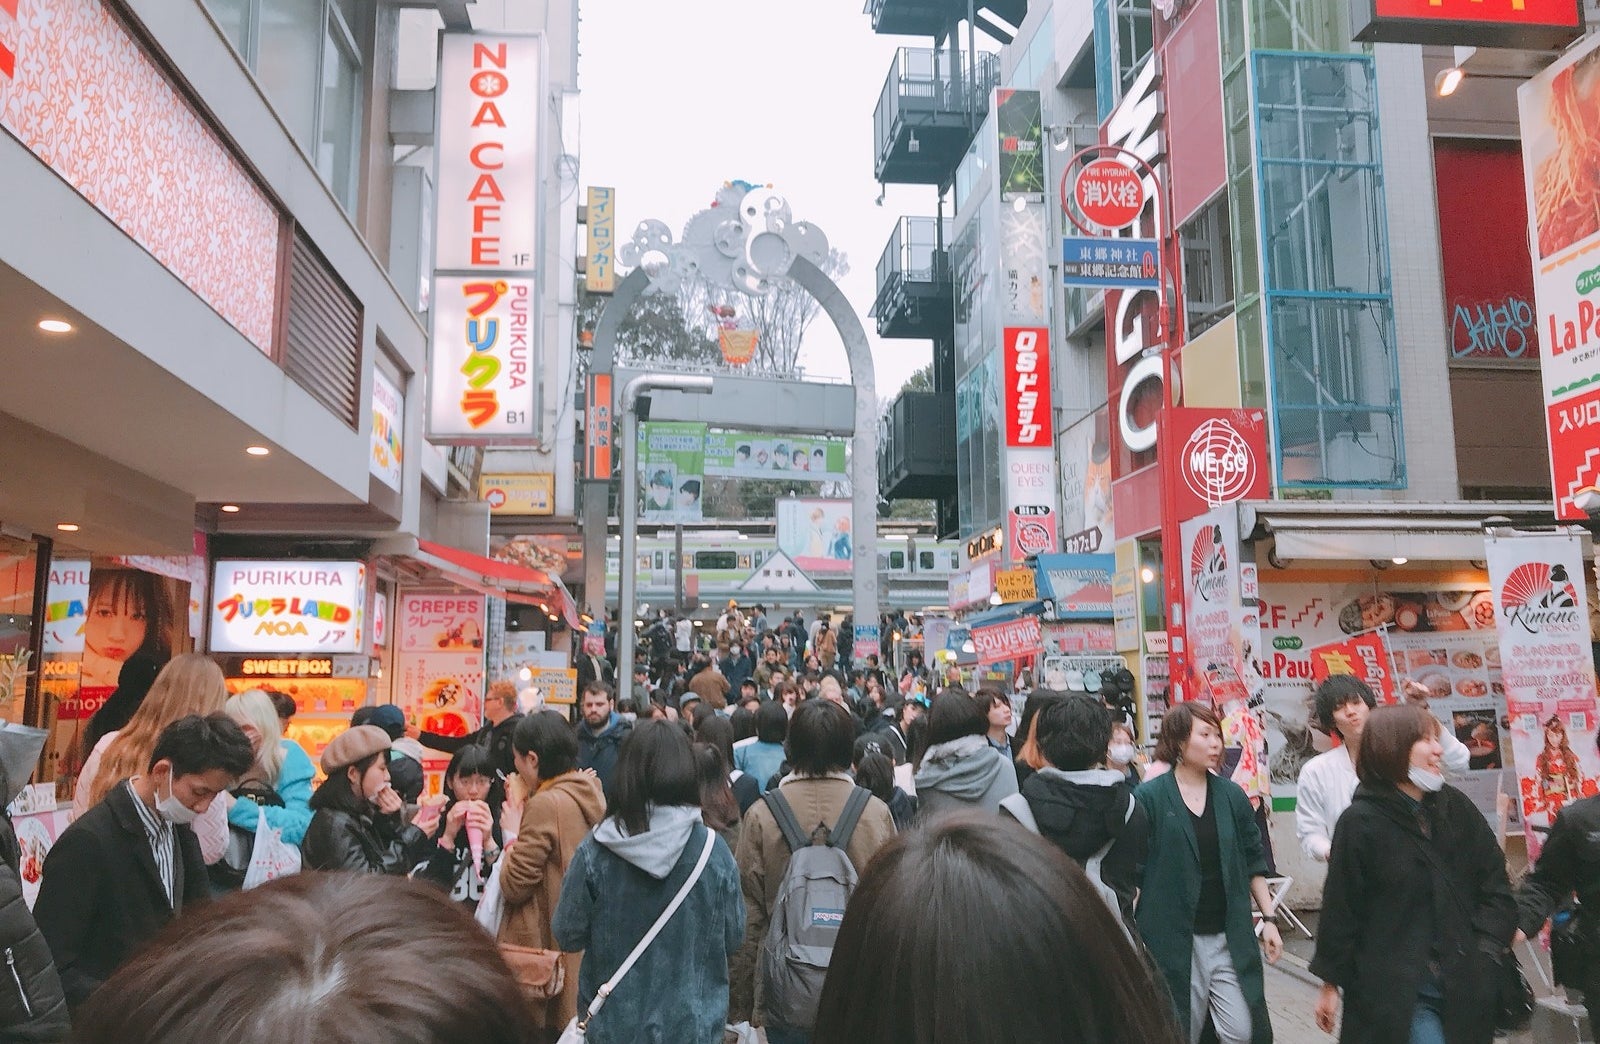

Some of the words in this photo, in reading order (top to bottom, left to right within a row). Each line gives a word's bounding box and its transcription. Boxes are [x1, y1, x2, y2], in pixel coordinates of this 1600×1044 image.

[469, 42, 509, 127] NOA
[1086, 168, 1100, 176] FIRE
[1102, 168, 1131, 177] HYDRANT
[1082, 180, 1138, 207] 消火栓
[467, 141, 506, 265] CAFE
[512, 254, 530, 266] 1F
[1080, 246, 1138, 262] 東郷神社
[1080, 263, 1142, 278] 東郷記念館
[509, 285, 528, 390] PURIKURA
[1549, 313, 1577, 357] La
[459, 280, 509, 430] プリクラ
[506, 411, 525, 424] B1
[1559, 400, 1600, 434] 入り口
[1011, 463, 1050, 474] QUEEN
[1017, 477, 1044, 487] EYES
[232, 570, 343, 586] PURIKURA
[1000, 589, 1020, 600] HAPPY
[1021, 587, 1034, 599] ONE
[1244, 583, 1256, 594] 3F
[408, 600, 478, 613] CREPES
[1258, 600, 1286, 629] 2F
[408, 616, 455, 628] クレープ
[1503, 600, 1579, 634] Kimono
[254, 620, 308, 636] NOA
[319, 630, 345, 644] ノア
[975, 625, 1040, 653] SOUVENIR
